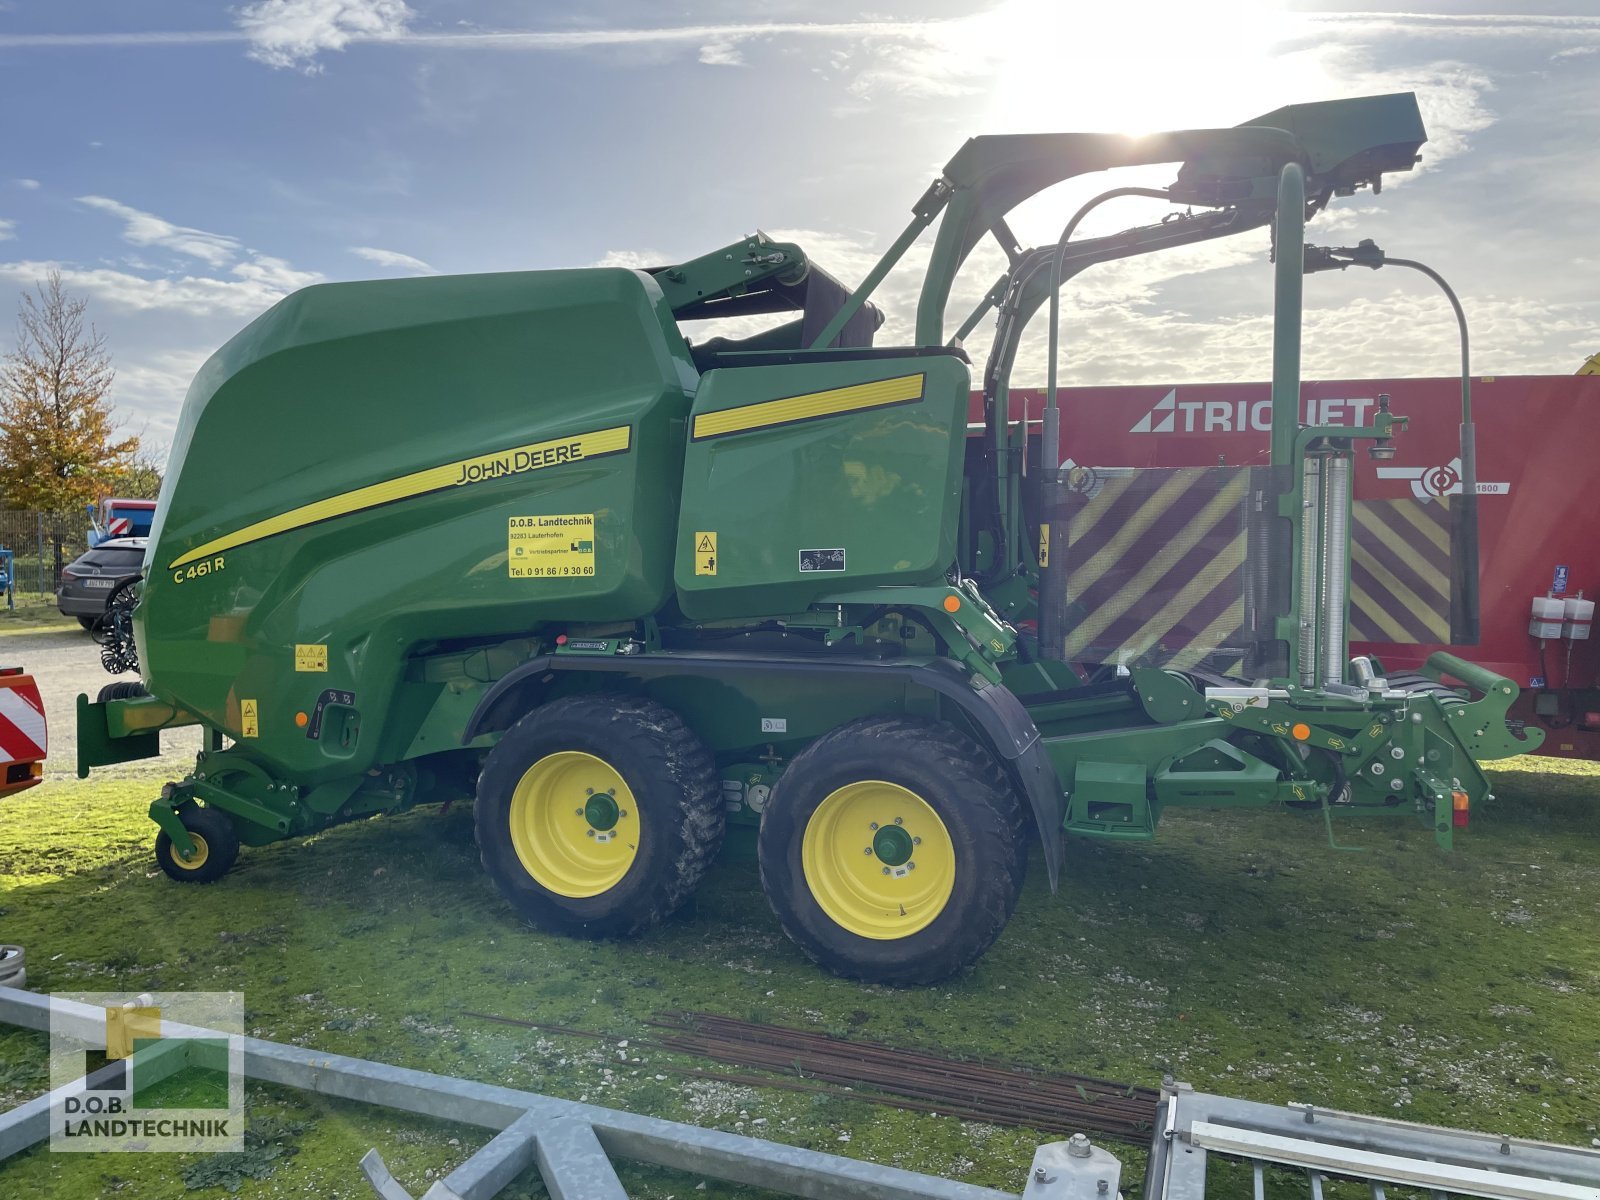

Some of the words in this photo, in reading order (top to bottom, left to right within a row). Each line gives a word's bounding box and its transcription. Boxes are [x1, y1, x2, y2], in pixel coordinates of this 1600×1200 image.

[456, 458, 510, 483] JOHN
[514, 443, 583, 470] DEERE
[1476, 484, 1498, 492] 1800
[510, 518, 536, 528] D.O.B.
[538, 516, 592, 526] Landtechnik
[174, 570, 183, 584] C
[186, 560, 212, 578] 461
[214, 557, 225, 571] R
[511, 568, 525, 576] Tel.
[534, 567, 544, 575] 91
[546, 567, 557, 575] 86
[558, 567, 562, 575] /
[571, 566, 581, 574] 30
[583, 566, 593, 574] 60
